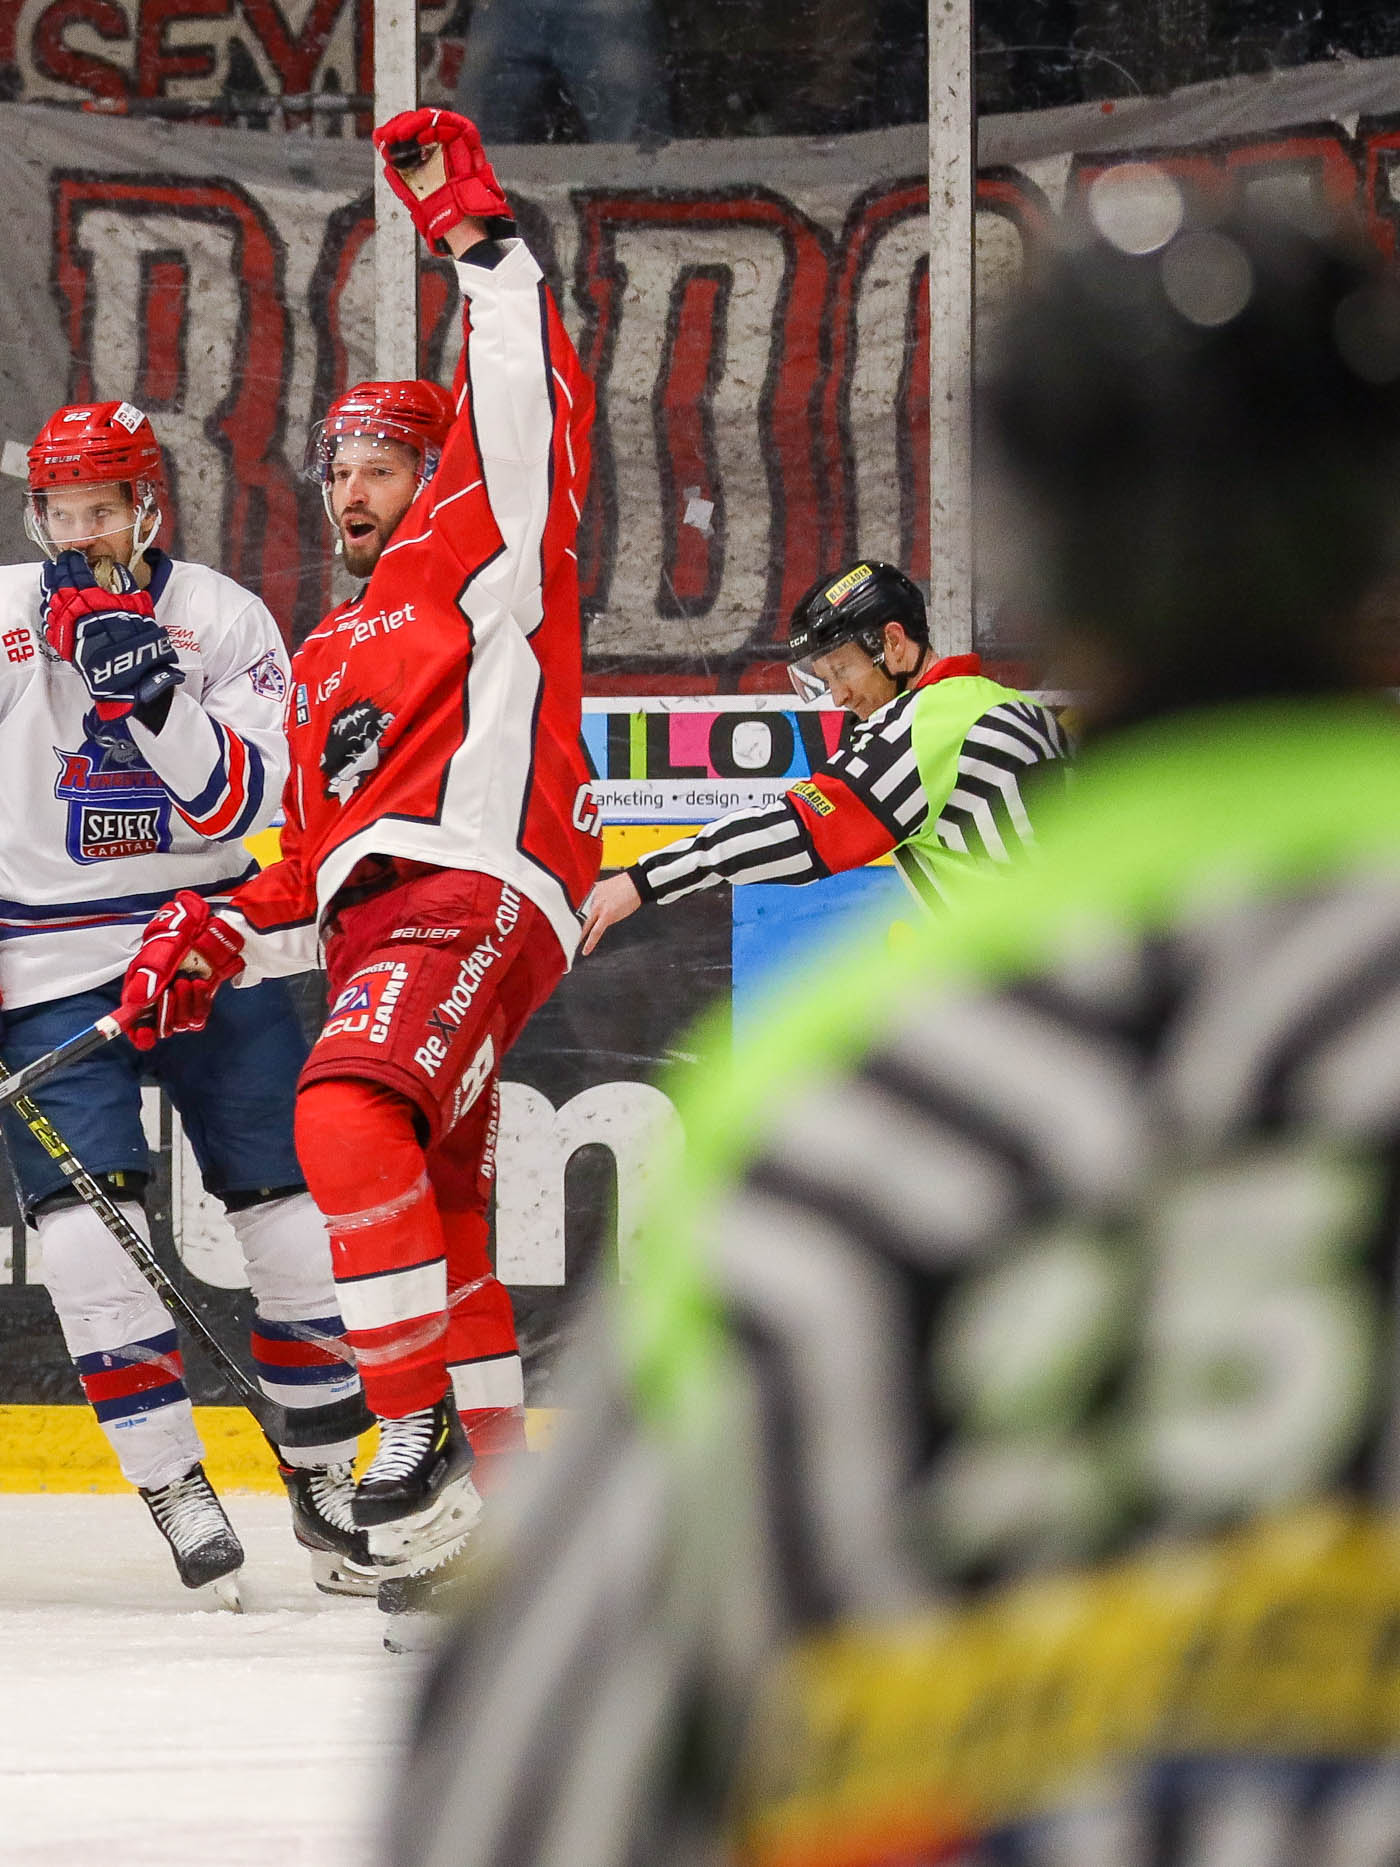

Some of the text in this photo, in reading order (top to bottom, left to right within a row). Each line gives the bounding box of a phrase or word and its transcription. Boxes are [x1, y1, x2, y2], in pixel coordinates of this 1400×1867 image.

[63, 411, 92, 423] 62
[350, 602, 417, 649] eriet
[789, 632, 808, 648] CCM
[595, 790, 663, 809] arketing
[686, 790, 740, 810] design
[87, 814, 154, 841] SEIER
[86, 841, 153, 857] CAPITAL
[369, 961, 409, 1044] CAMP
